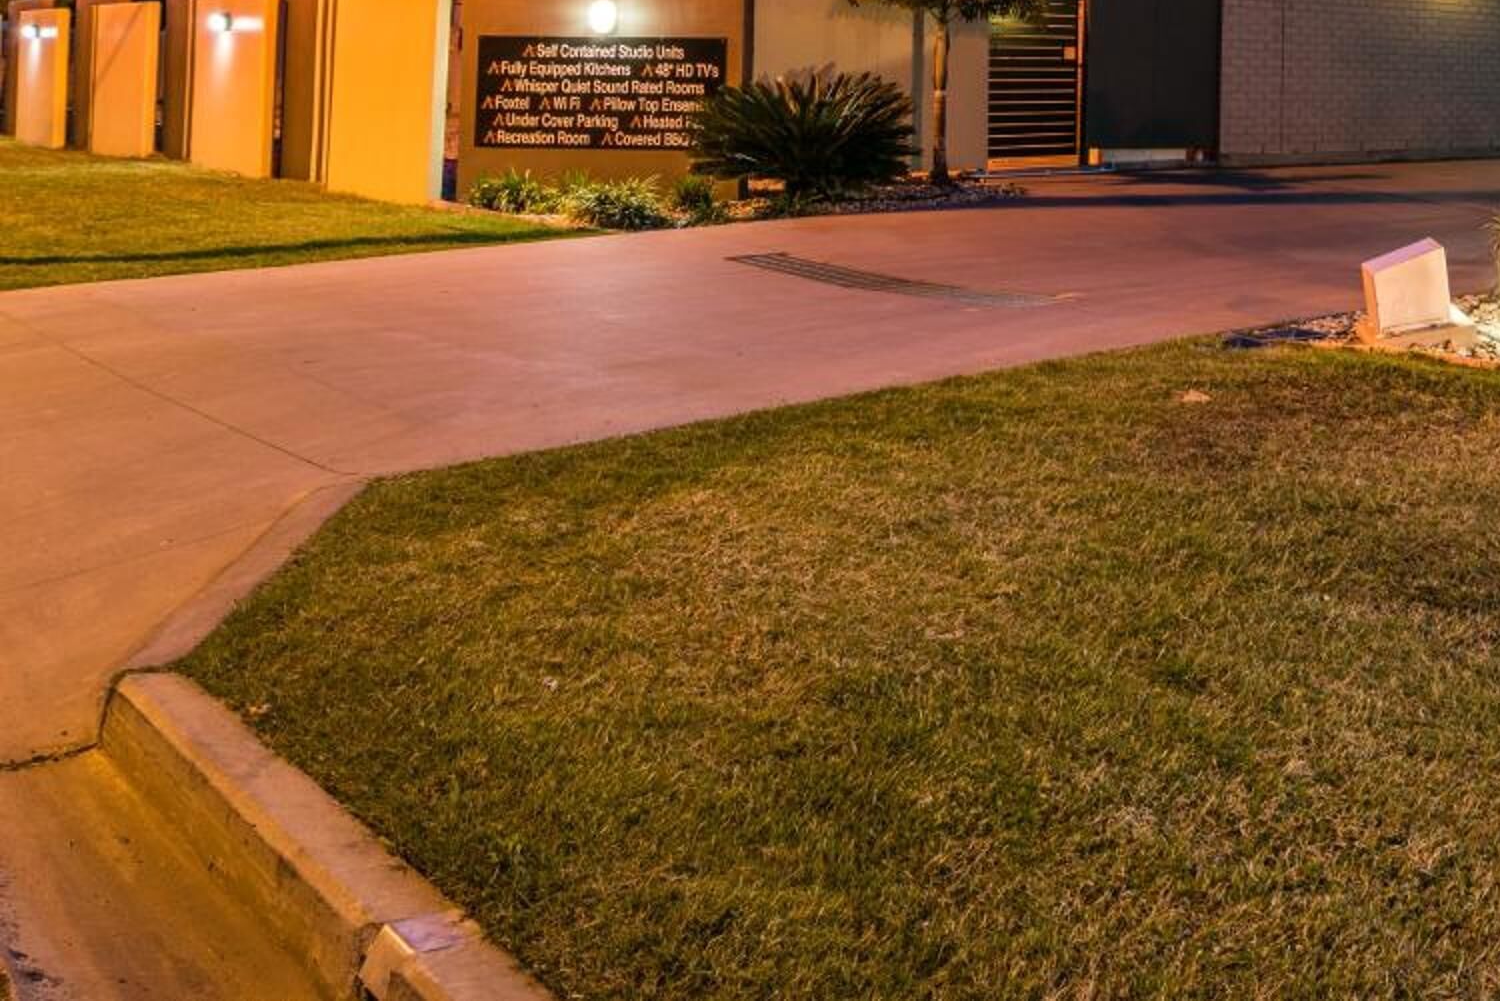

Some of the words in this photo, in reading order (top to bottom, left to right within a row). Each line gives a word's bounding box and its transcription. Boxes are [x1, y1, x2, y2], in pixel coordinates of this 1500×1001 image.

[537, 43, 558, 58] Self
[560, 44, 616, 58] Contained
[618, 44, 654, 59] Studio
[655, 45, 685, 59] Units
[501, 60, 527, 77] Fully
[529, 60, 581, 78] Equipped
[583, 62, 631, 76] Kitchens
[675, 63, 694, 77] HD
[514, 79, 559, 95] Whisper
[561, 79, 591, 94] Quiet
[593, 80, 629, 94] Sound
[631, 80, 663, 94] Rated
[665, 80, 705, 95] Rooms
[495, 95, 530, 110] Foxtel
[603, 97, 636, 111] Pillow
[638, 98, 659, 114] Top
[505, 112, 539, 127] Under
[541, 113, 574, 128] Cover
[576, 113, 619, 132] Parking
[643, 114, 683, 129] Heated
[496, 130, 555, 145] Recreation
[557, 130, 591, 145] Room
[615, 131, 661, 146] Covered
